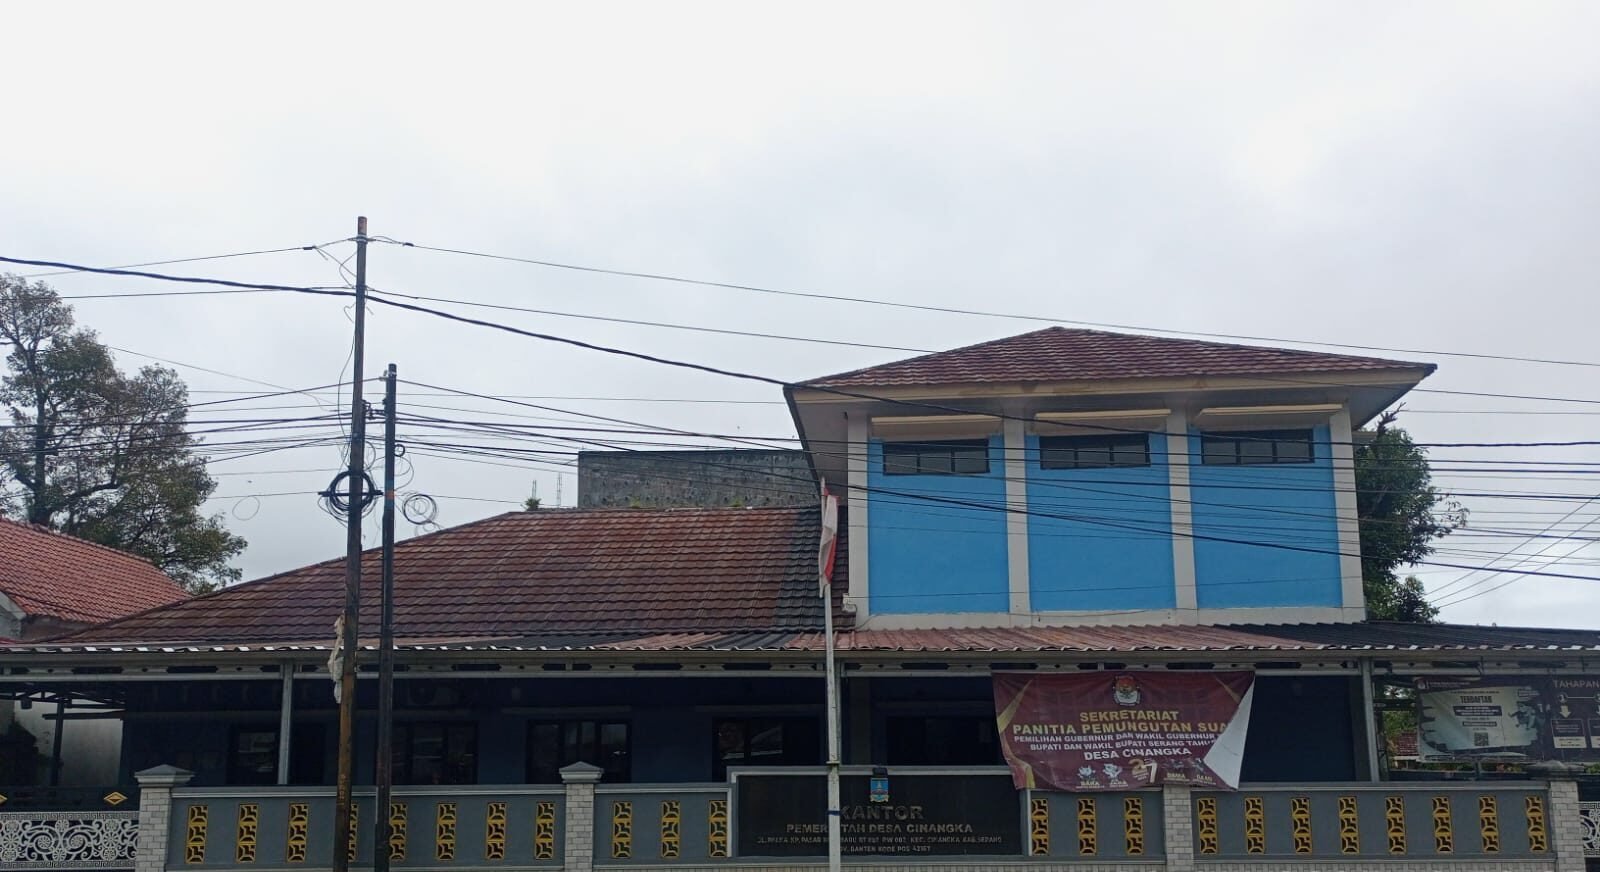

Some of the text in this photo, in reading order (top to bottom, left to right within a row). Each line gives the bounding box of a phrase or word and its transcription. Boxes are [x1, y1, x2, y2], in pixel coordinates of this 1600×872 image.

[1079, 709, 1179, 722] SEKRETARIAT
[1013, 724, 1076, 735] PANITIA
[1081, 721, 1192, 734] PEMUNGUTAN
[1014, 732, 1215, 743] PEMILIHAN GUBERNUR DAN WAKIL GUBERNUR
[1030, 743, 1061, 751] BUPATI
[1084, 742, 1113, 750] WAKIL
[1115, 740, 1146, 749] BUPATI
[1148, 739, 1185, 747] SERANG
[1083, 748, 1192, 761] DESA CINANGKA
[786, 823, 973, 833] PEMERTAH DESA CINANGKA
